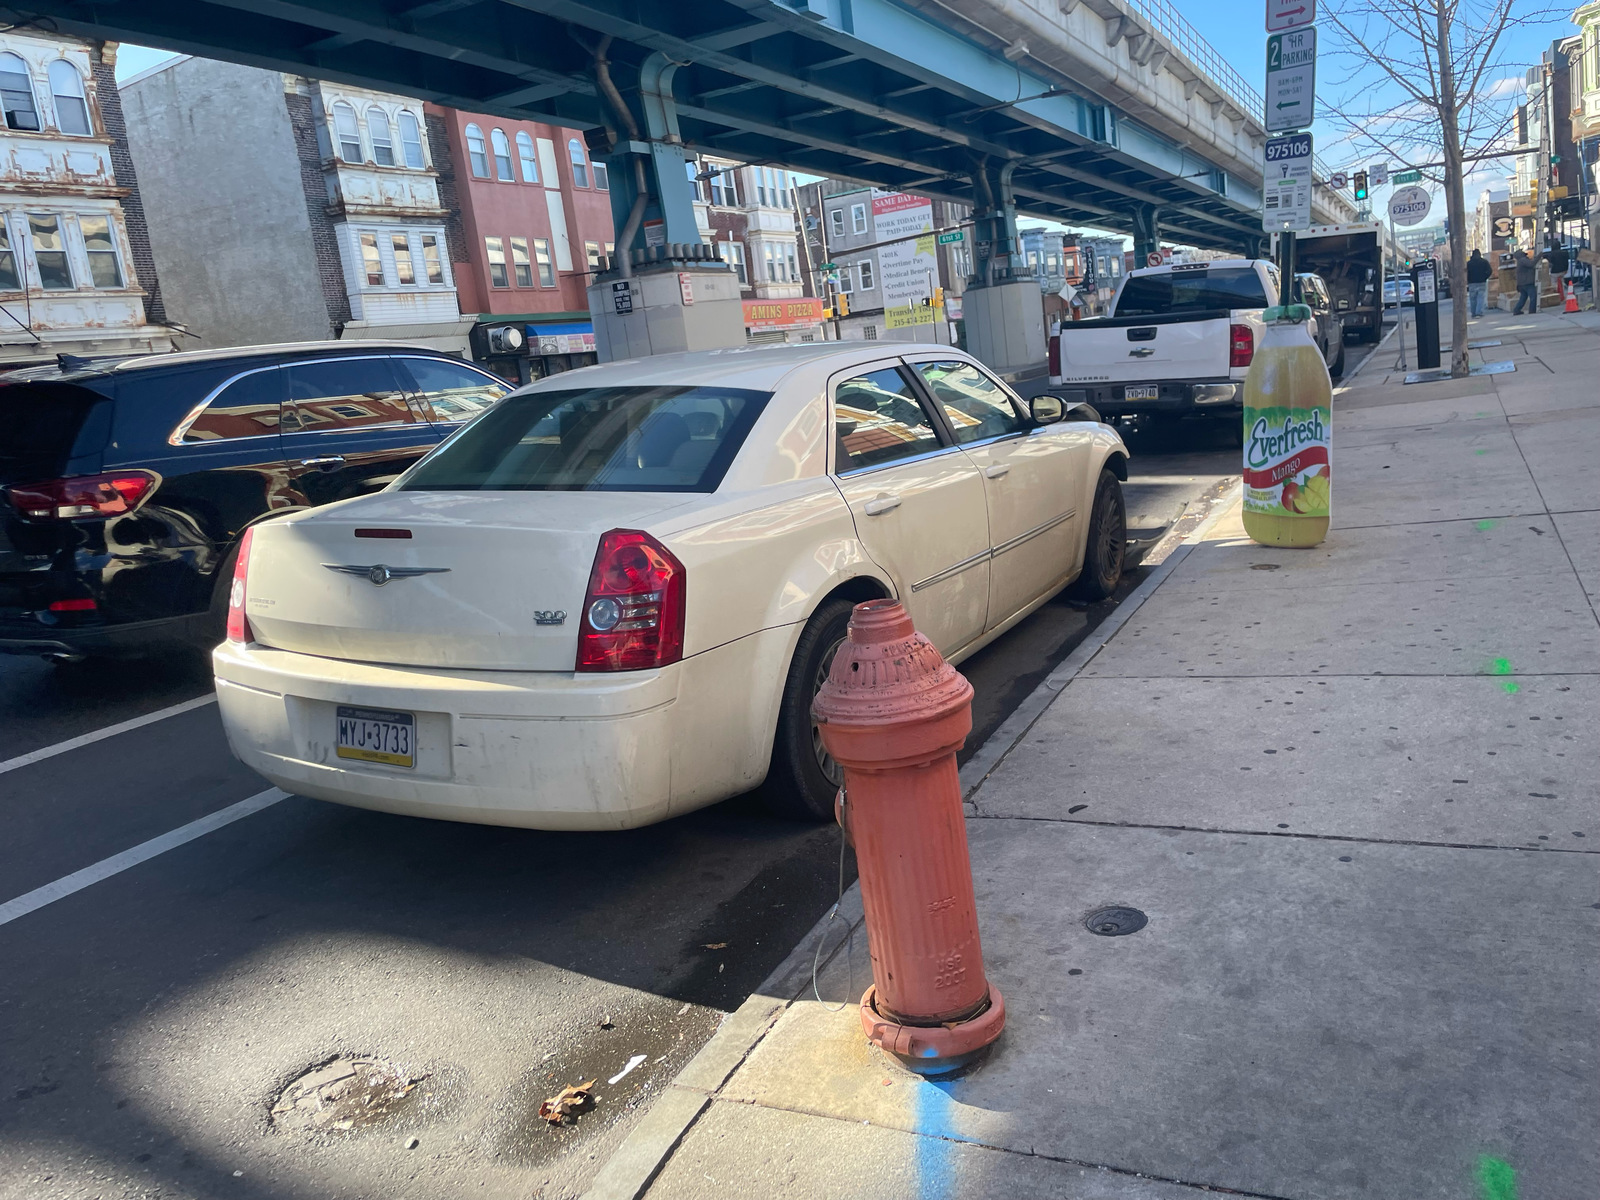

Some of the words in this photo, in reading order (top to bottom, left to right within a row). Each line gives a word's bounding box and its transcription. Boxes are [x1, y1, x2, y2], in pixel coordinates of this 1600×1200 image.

[1270, 42, 1279, 66] 2
[1291, 35, 1304, 48] HR
[1282, 48, 1313, 66] PARKING
[1267, 141, 1309, 159] 975106
[874, 196, 896, 208] SAME
[897, 194, 911, 204] DAY
[1394, 202, 1425, 213] 975106
[876, 221, 896, 229] WORK
[896, 216, 917, 225] TODAY
[885, 260, 912, 269] Overtime
[886, 270, 909, 279] Medical
[910, 266, 935, 275] Benefits
[887, 282, 906, 290] Credit
[906, 278, 925, 287] Union
[888, 289, 926, 299] Membership
[751, 304, 782, 319] AMINS
[787, 303, 813, 318] PIZZA
[1248, 410, 1324, 468] Everfresh
[1272, 457, 1301, 482] Mango
[533, 610, 568, 620] 300
